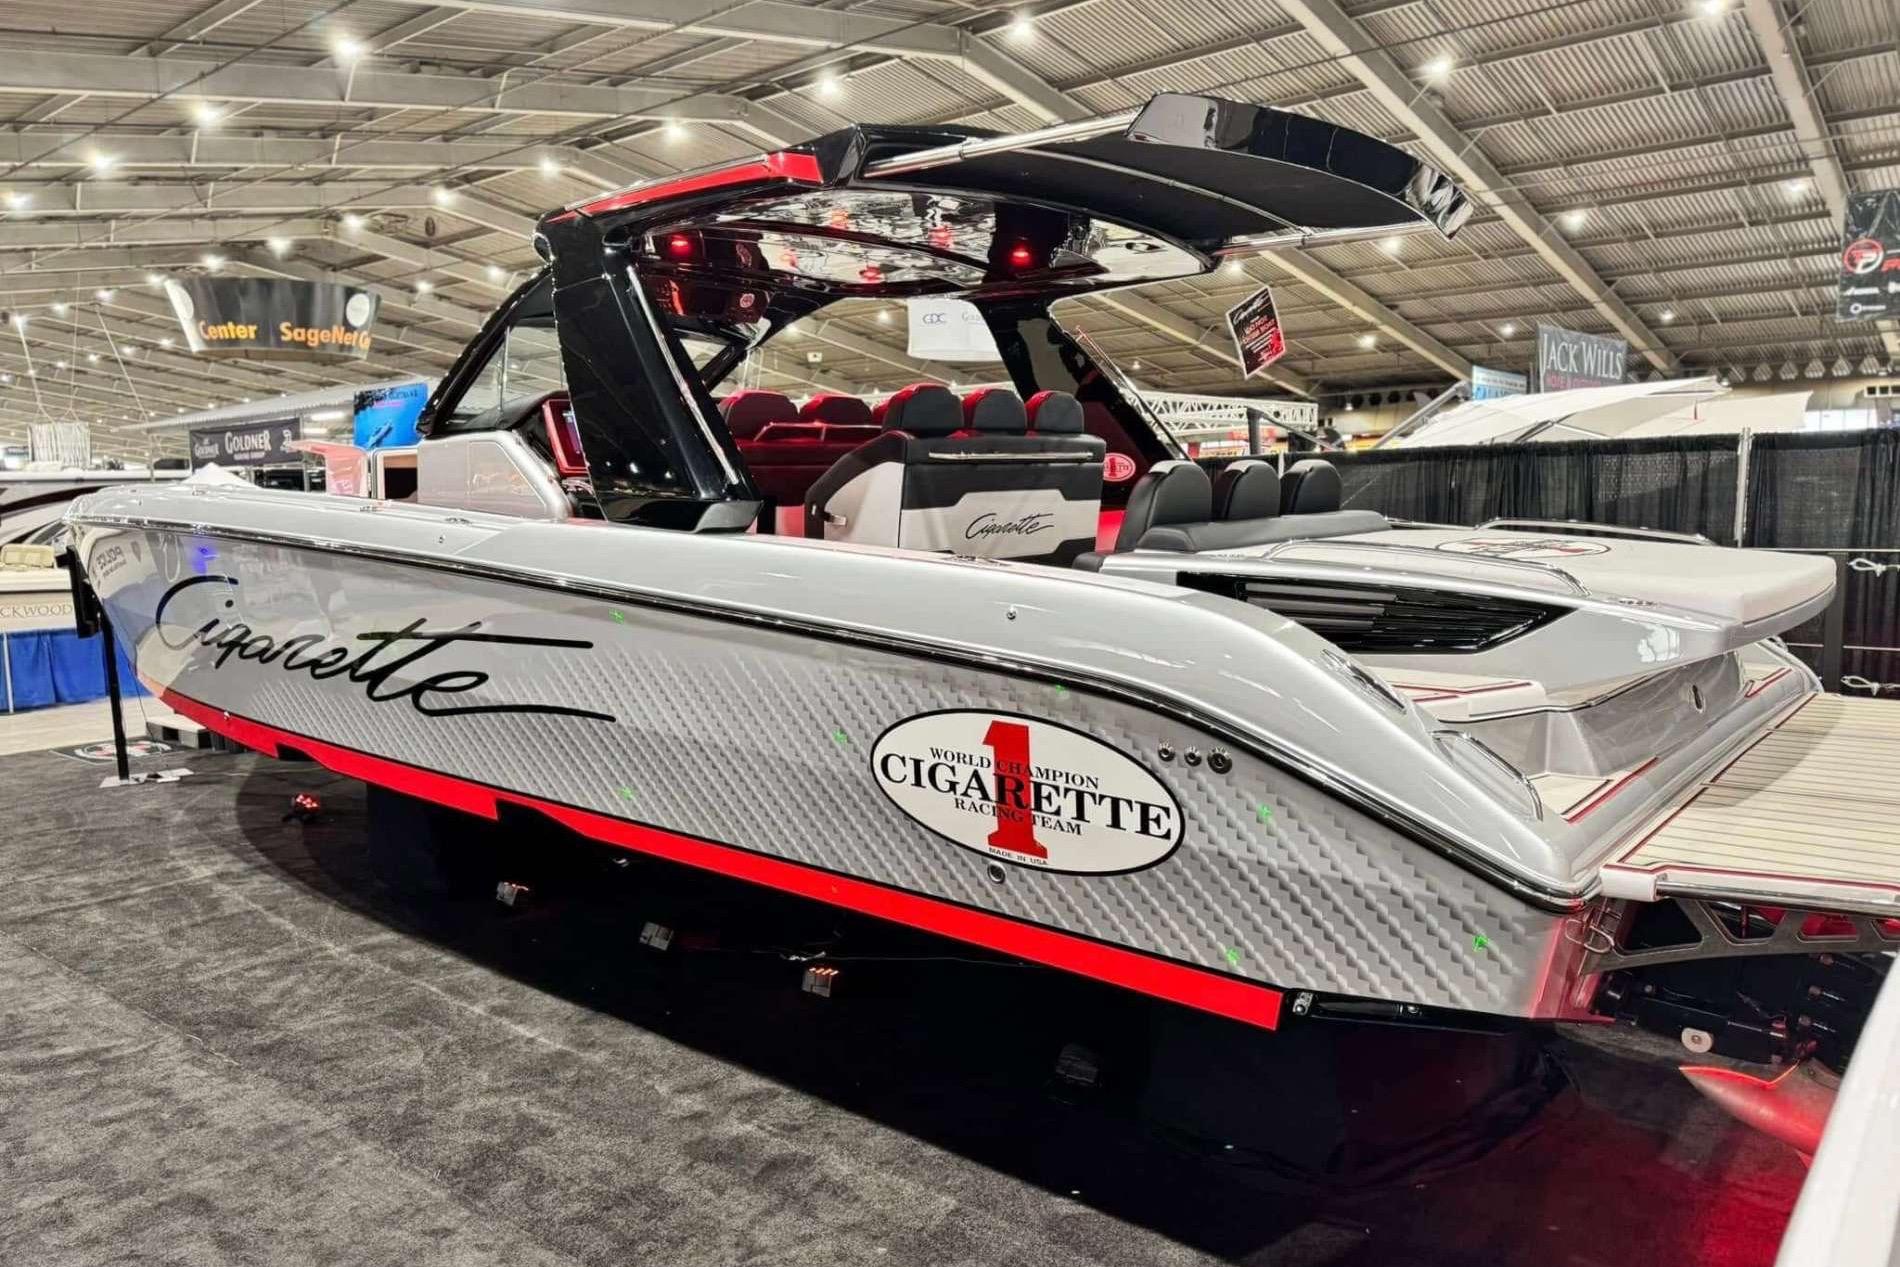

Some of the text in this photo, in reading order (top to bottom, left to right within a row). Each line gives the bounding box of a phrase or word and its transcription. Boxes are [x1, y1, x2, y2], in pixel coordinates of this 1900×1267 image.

[200, 320, 258, 341] Center
[279, 321, 358, 348] SageNet
[1540, 333, 1623, 380] JACK WILLS
[225, 429, 272, 454] GOLDNER
[965, 512, 1055, 539] Cigarette
[155, 574, 616, 723] Cigarette
[929, 746, 1099, 790] WORLD CHAMPION
[879, 752, 1172, 841] CIGARETTE
[954, 797, 1083, 836] RACING TEAM
[988, 846, 1048, 866] MADE IN USA
